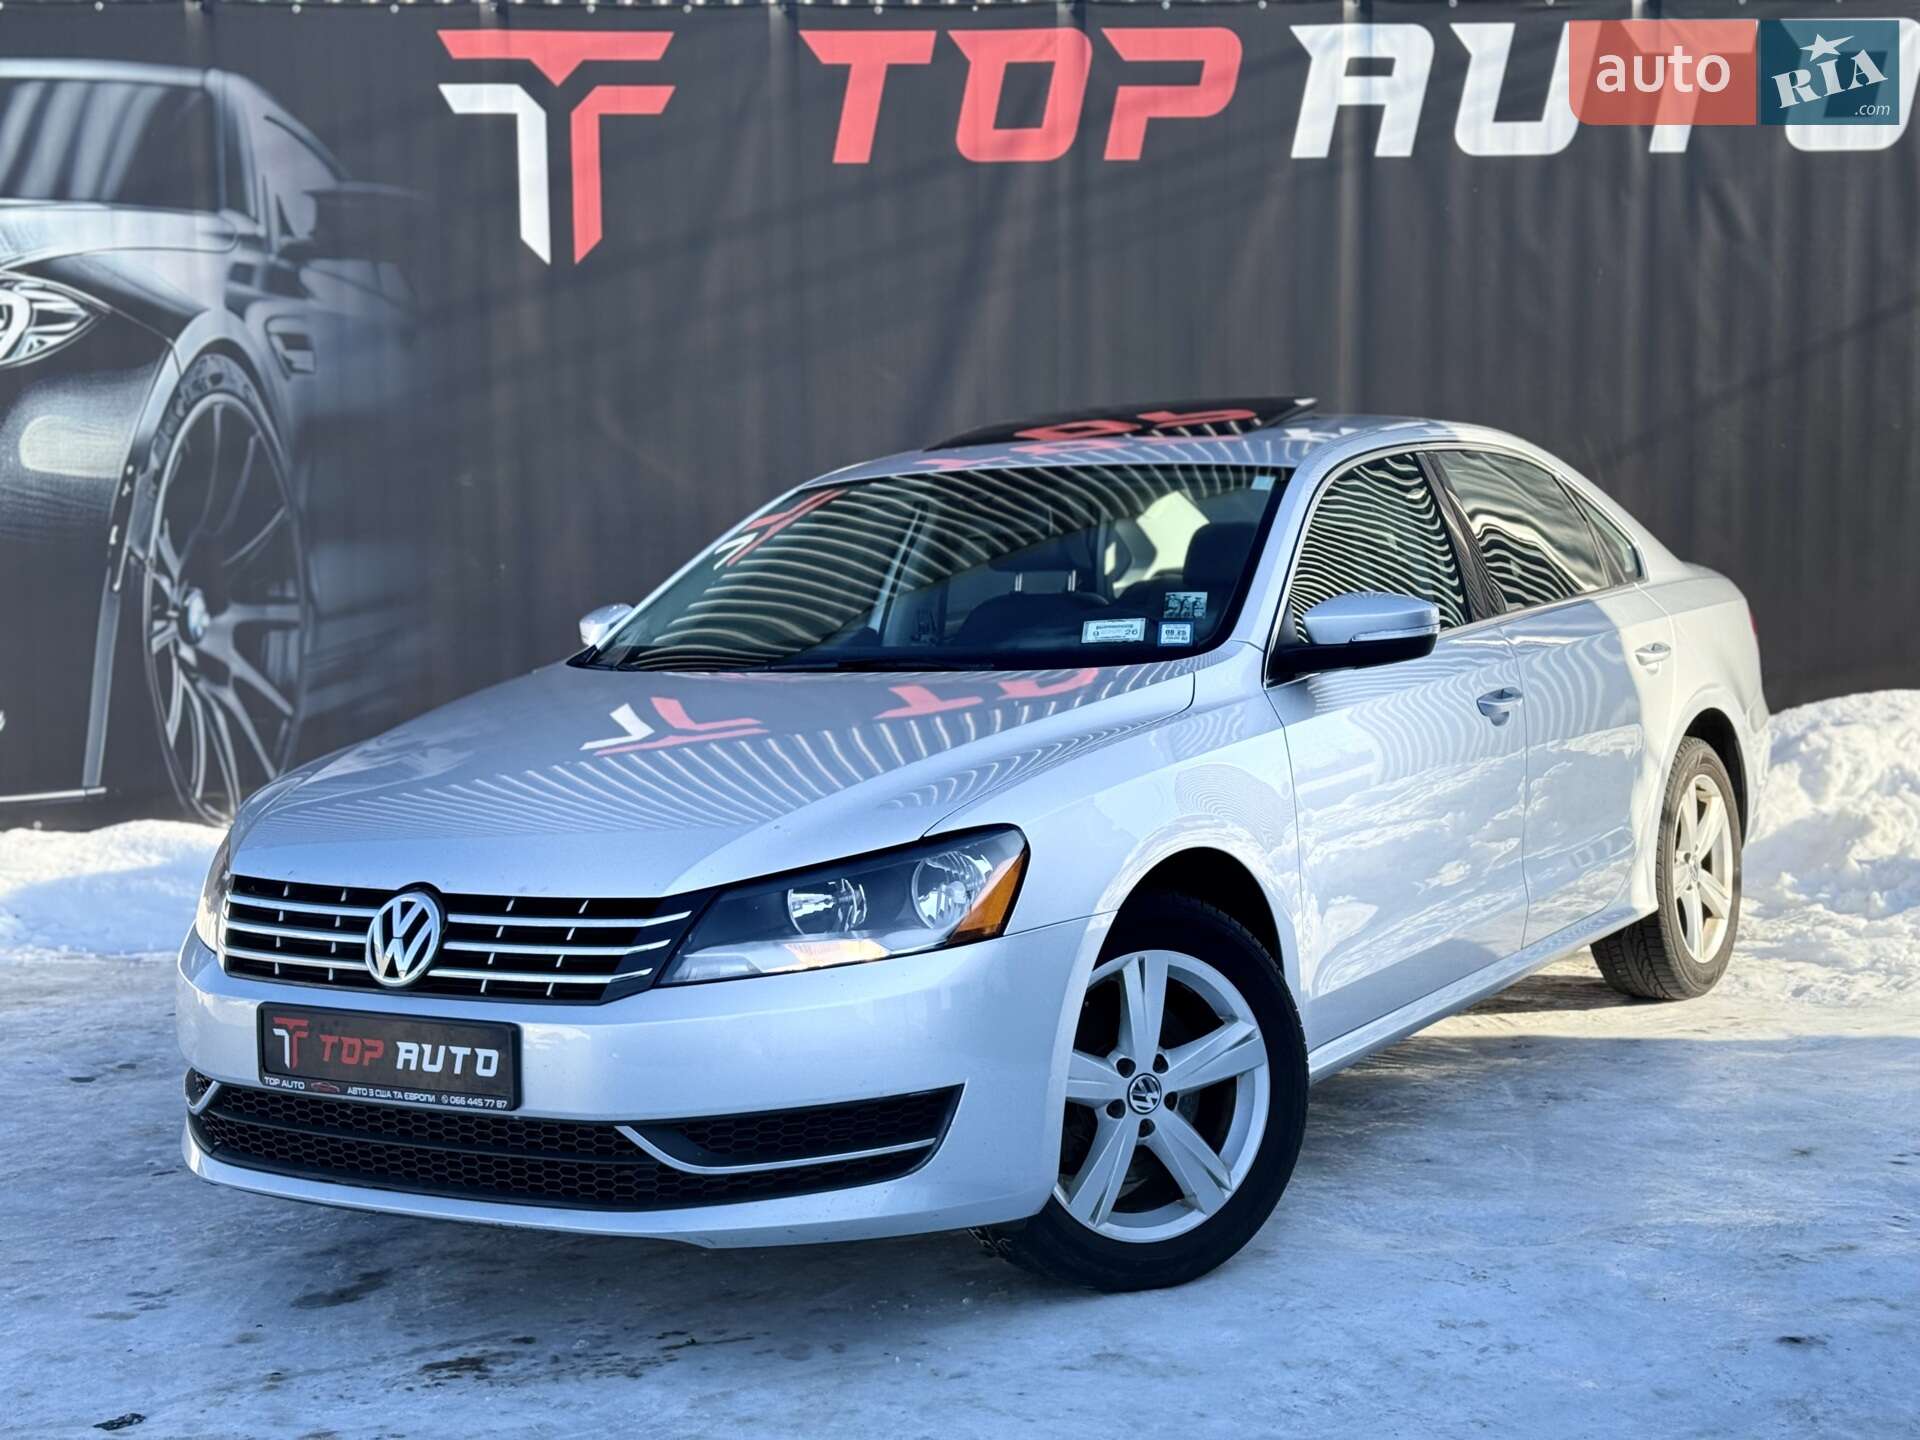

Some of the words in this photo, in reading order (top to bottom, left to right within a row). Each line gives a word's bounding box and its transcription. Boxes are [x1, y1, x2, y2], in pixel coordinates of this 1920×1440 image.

[799, 27, 1242, 163] TOP
[1290, 19, 1920, 158] AUTO
[365, 891, 440, 987] VW
[319, 1034, 384, 1066] TOP
[396, 1041, 499, 1077] AUTO
[264, 1076, 281, 1087] TOP
[281, 1079, 305, 1090] AUTO
[484, 1099, 495, 1108] 77
